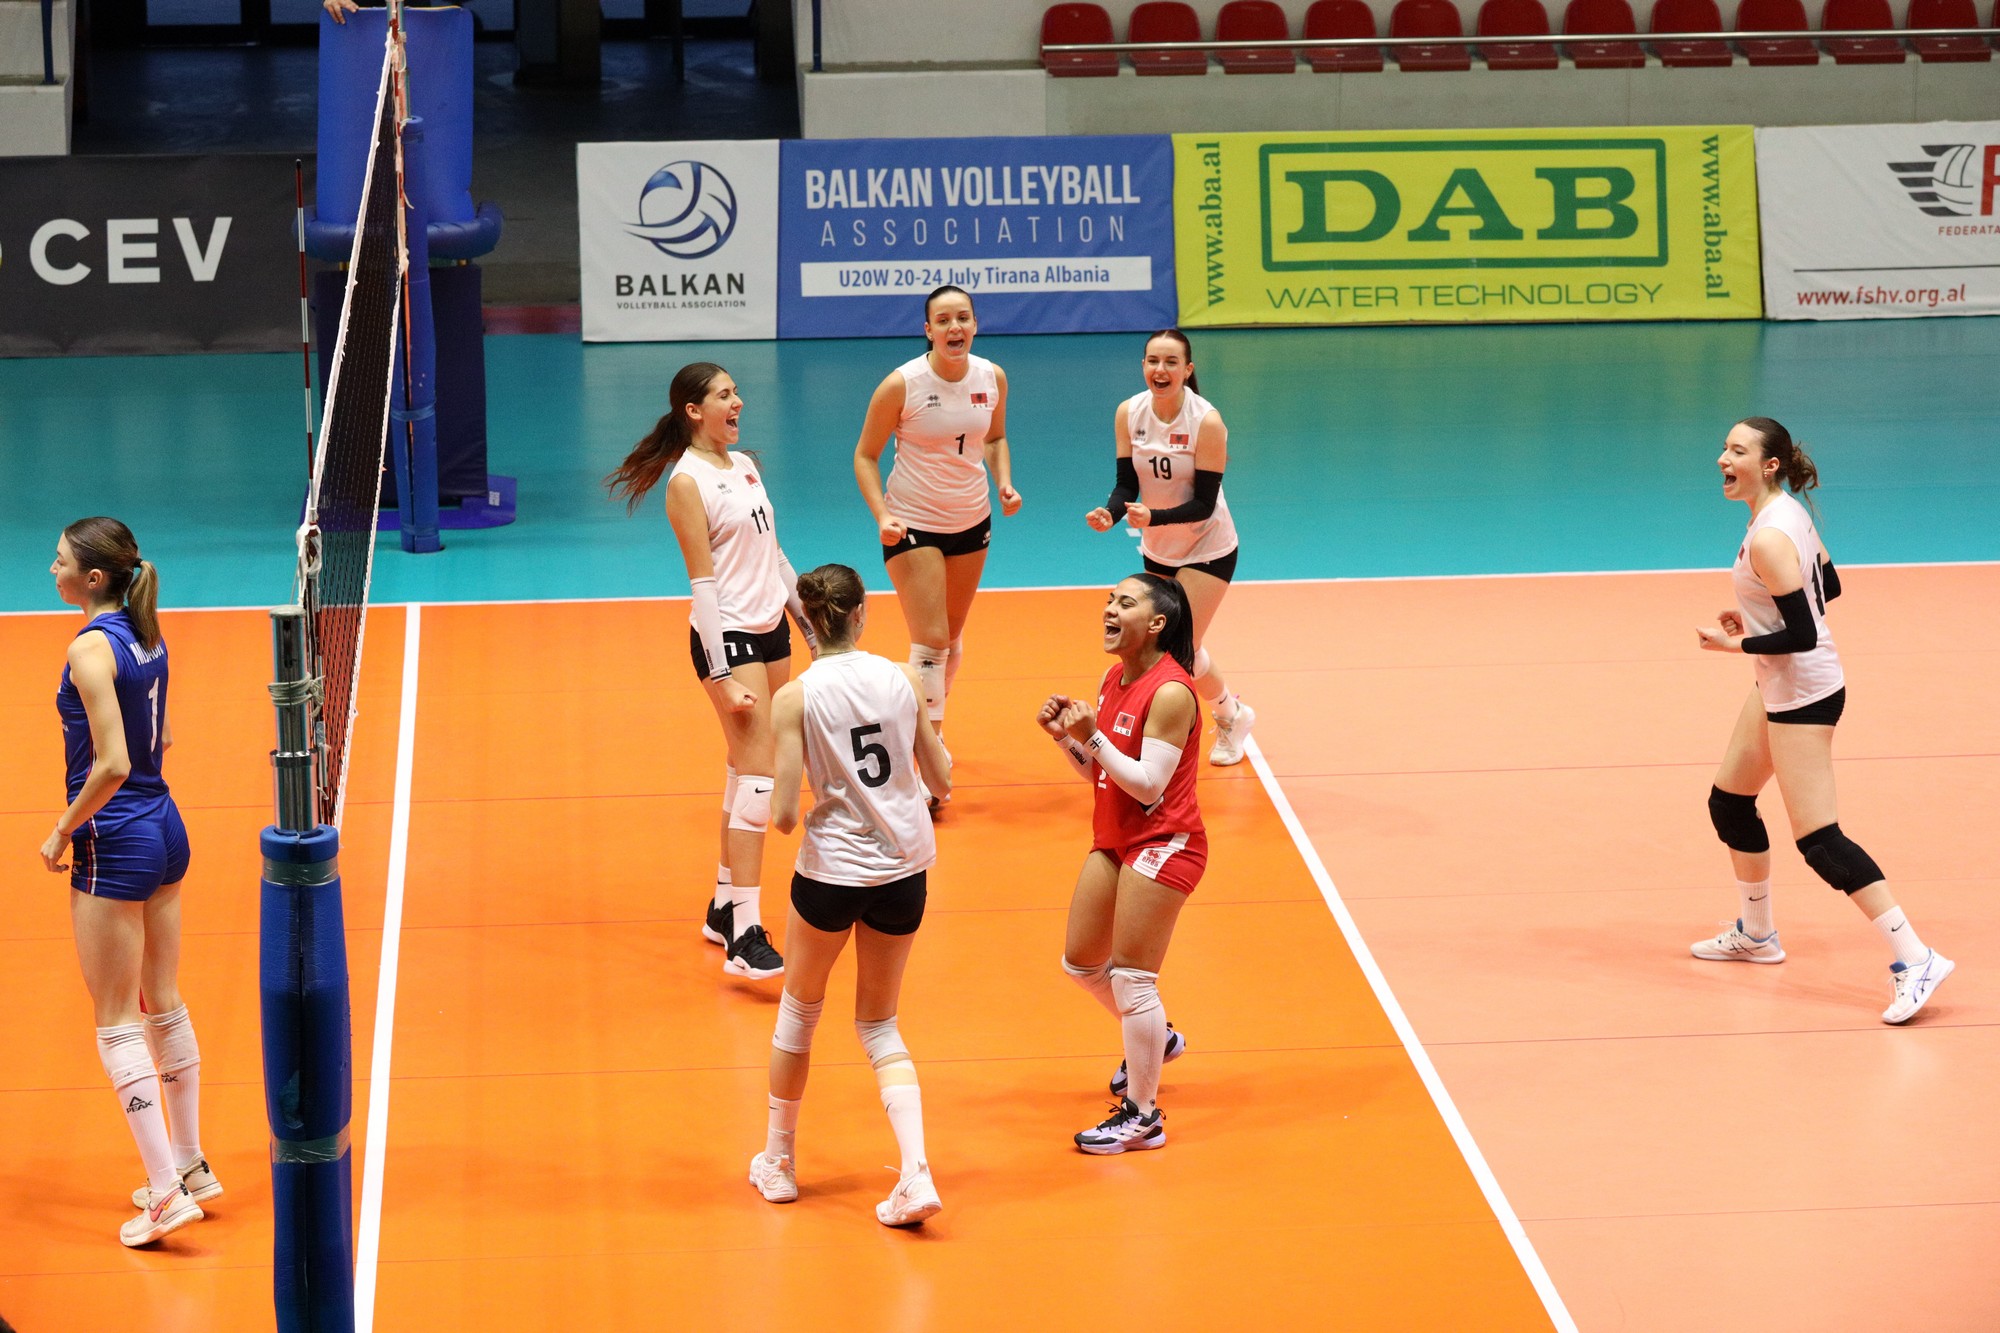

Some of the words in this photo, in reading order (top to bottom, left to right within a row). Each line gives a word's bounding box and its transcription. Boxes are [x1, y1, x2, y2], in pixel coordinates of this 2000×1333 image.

[805, 168, 933, 209] BALKAN
[941, 164, 1141, 207] VOLLEYBALL
[1285, 167, 1639, 244] DAB
[1701, 134, 1731, 300] www.aba.al
[821, 215, 1124, 247] ASSOCIATION
[1196, 141, 1225, 307] www.aba.al
[29, 216, 233, 285] CEV
[615, 273, 745, 297] BALKAN
[839, 269, 889, 287] U20W
[894, 268, 943, 287] 20-24
[947, 267, 981, 289] July
[985, 266, 1040, 285] Tirana
[1045, 265, 1110, 284] Albania
[617, 301, 677, 310] VOLLEYBALL
[681, 300, 746, 309] ASSOCIATION
[1266, 286, 1398, 309] WATER
[1409, 283, 1663, 307] TECHNOLOGY
[1797, 283, 1966, 308] www.fshv.org.al
[955, 434, 966, 455] 1
[1148, 456, 1172, 480] 19
[751, 505, 769, 535] 11
[148, 676, 159, 753] 1
[850, 723, 892, 788] 5
